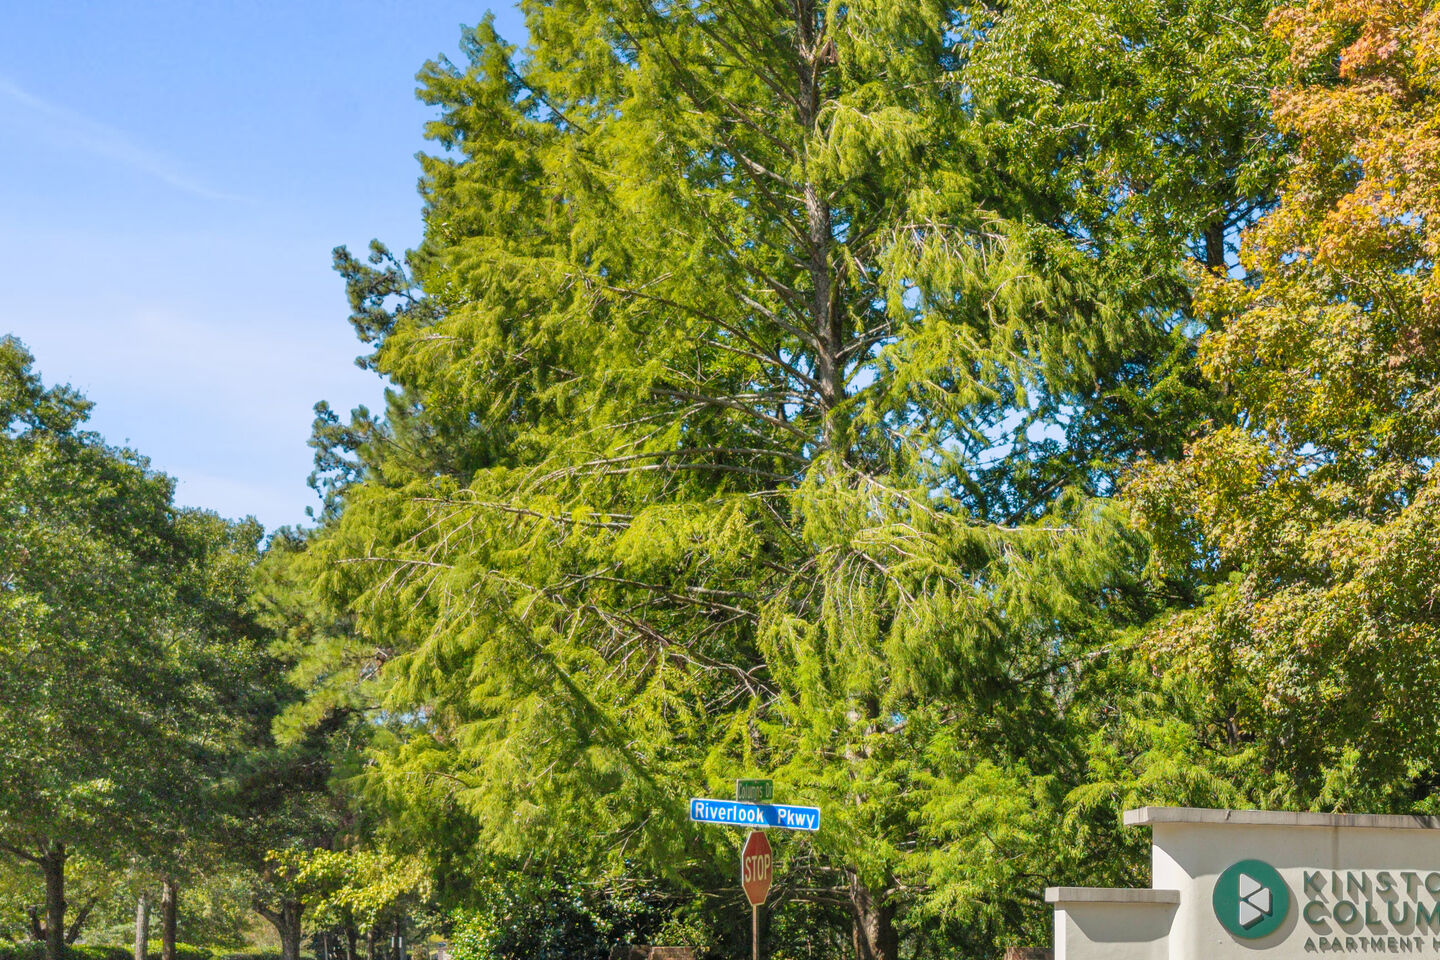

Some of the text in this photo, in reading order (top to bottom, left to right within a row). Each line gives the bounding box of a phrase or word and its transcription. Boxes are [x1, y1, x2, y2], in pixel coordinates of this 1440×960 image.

[695, 802, 815, 830] Riverlook Pkwy
[745, 853, 770, 883] STOP
[1304, 936, 1424, 950] APARTMENT
